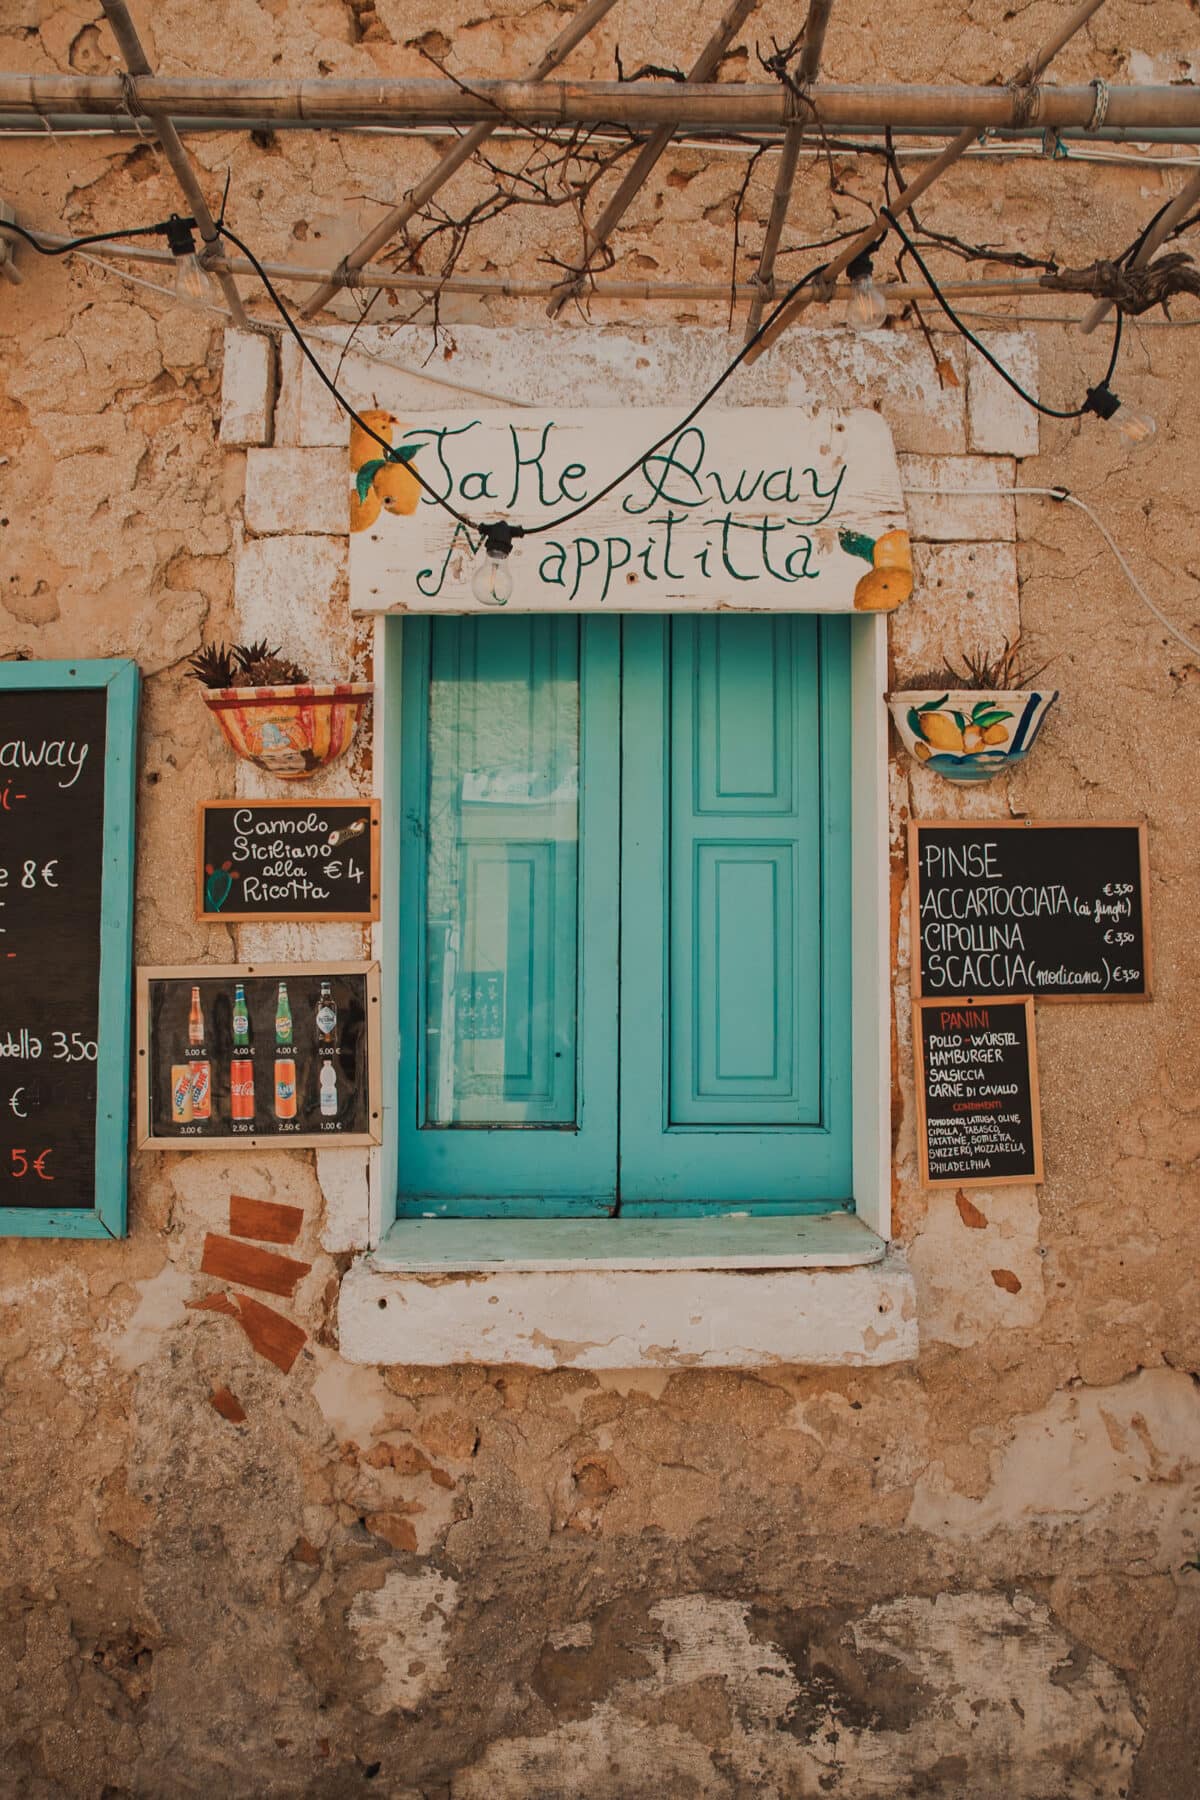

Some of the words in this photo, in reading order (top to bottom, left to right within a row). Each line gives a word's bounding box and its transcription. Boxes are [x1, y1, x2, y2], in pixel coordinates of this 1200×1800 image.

[622, 427, 847, 525] Away
[0, 740, 89, 788] away
[233, 809, 329, 836] Cannolo
[232, 836, 333, 861] Siciliano
[925, 843, 1003, 879] PINSE
[262, 860, 308, 878] alla
[243, 876, 331, 903] Ricotta
[921, 885, 1072, 920] ACCARTOCCIATA
[924, 922, 1025, 952] CIPOLLINA
[941, 1009, 989, 1030] PANINI
[51, 1031, 98, 1063] 3,50
[929, 1035, 962, 1049] POLLO
[929, 1048, 1004, 1066] HAMBURGER
[929, 1068, 985, 1082] SALSICCIA
[928, 1083, 963, 1097] CARNE
[966, 1086, 977, 1097] DI
[979, 1083, 1018, 1096] CAVALLO
[929, 1159, 991, 1173] PHILADELPHIA
